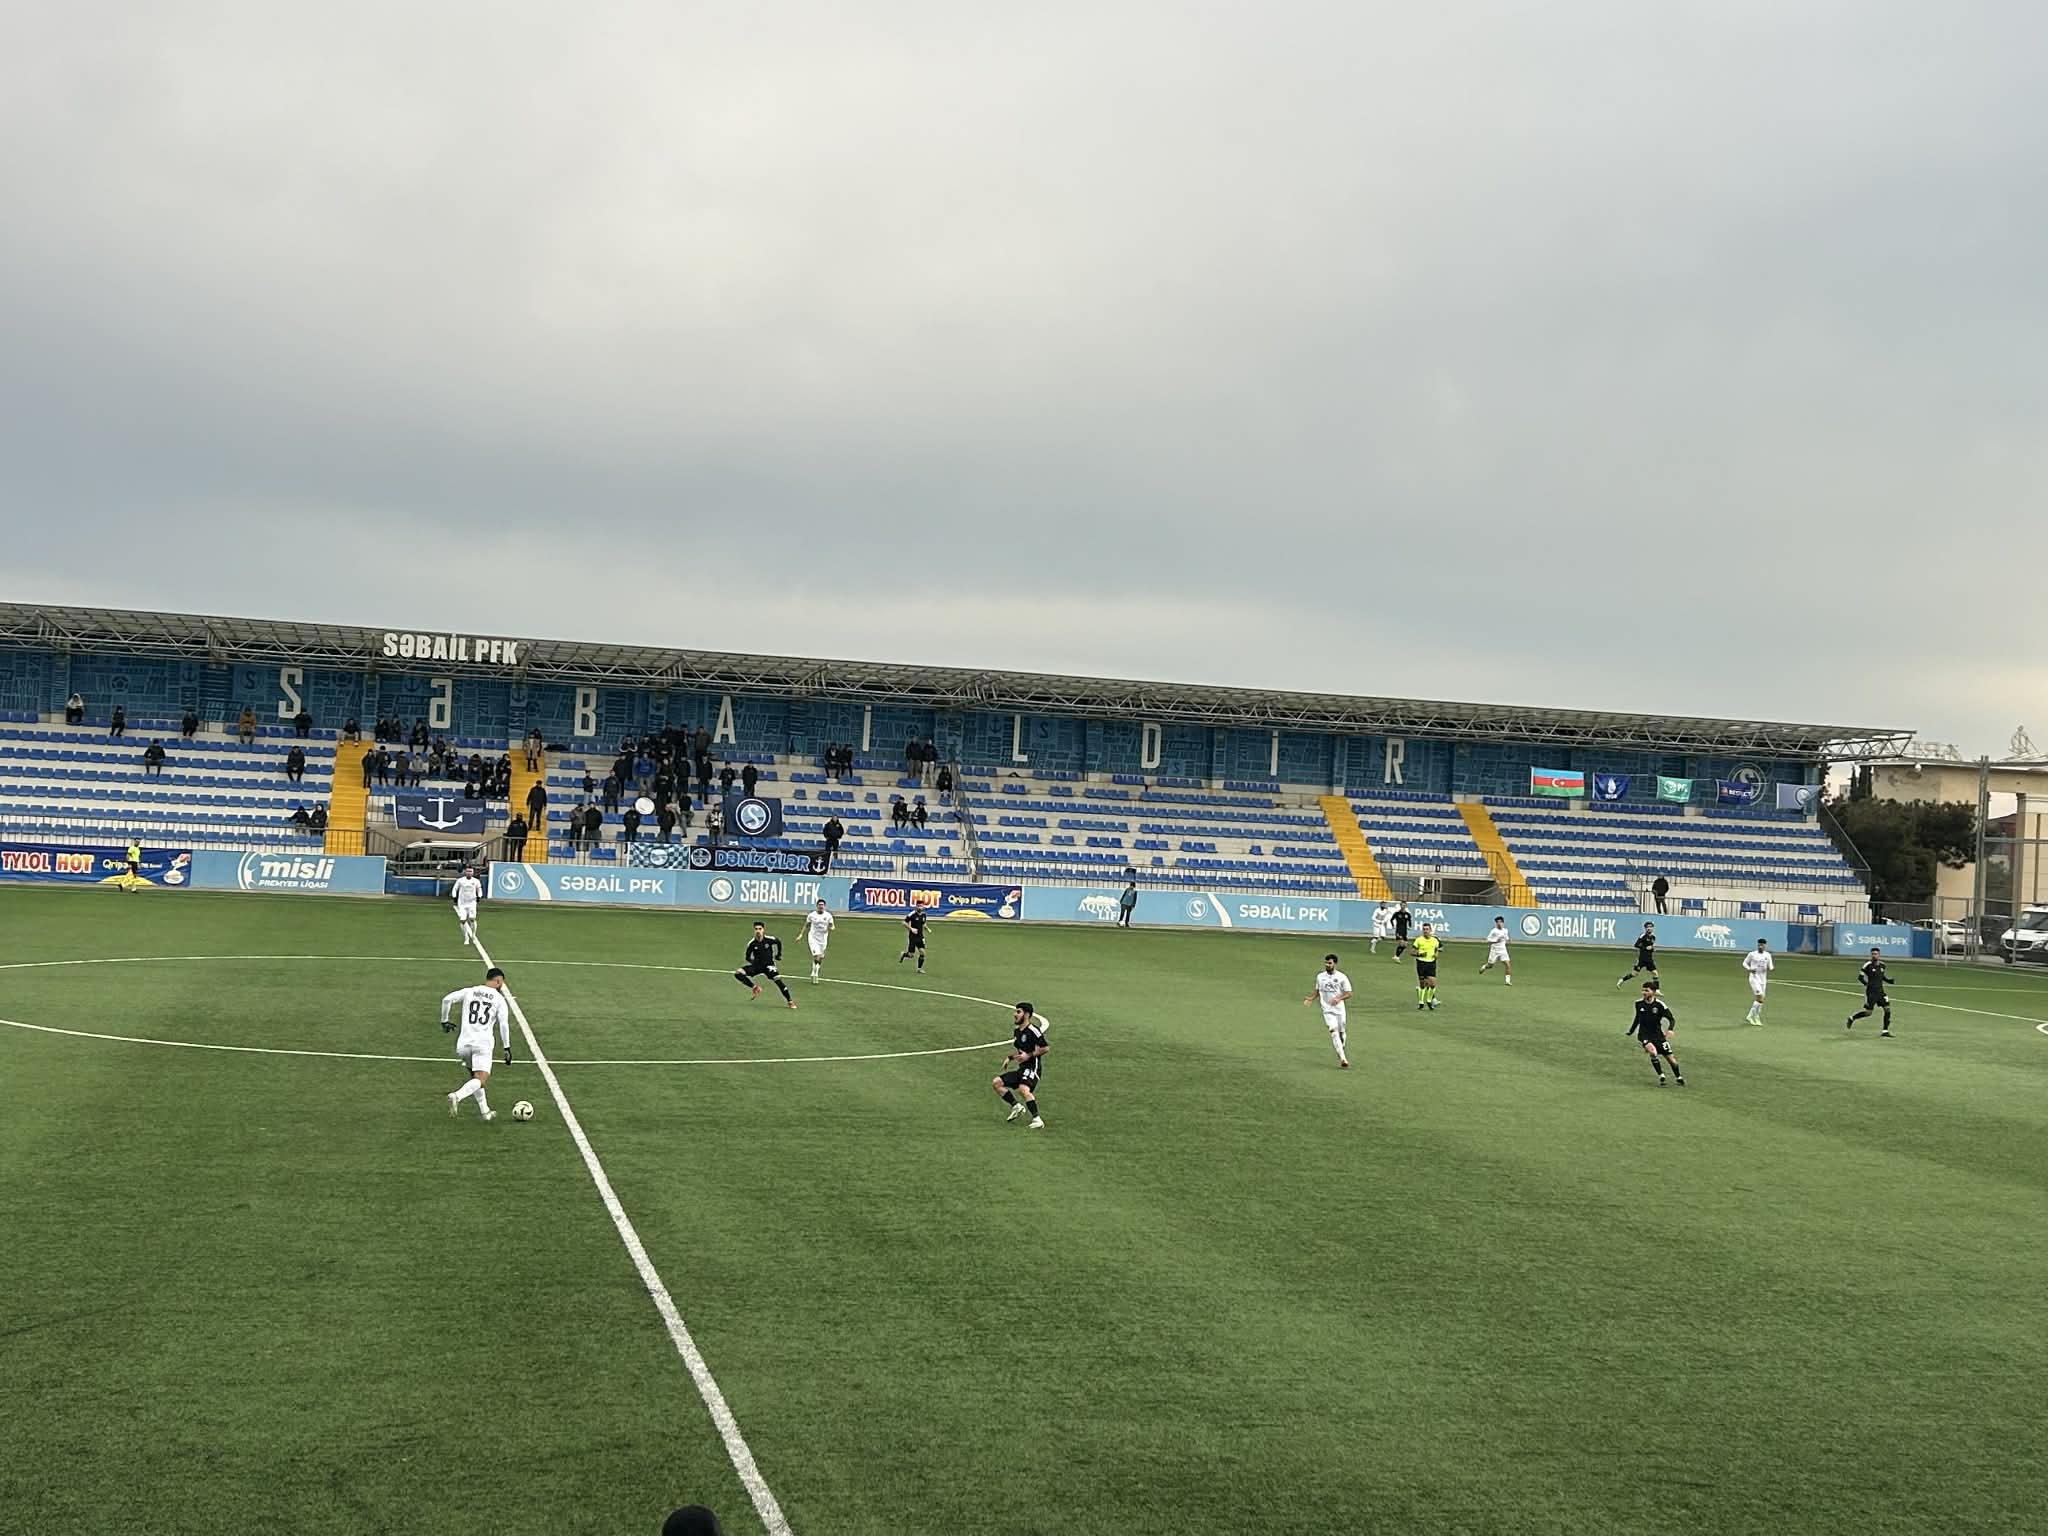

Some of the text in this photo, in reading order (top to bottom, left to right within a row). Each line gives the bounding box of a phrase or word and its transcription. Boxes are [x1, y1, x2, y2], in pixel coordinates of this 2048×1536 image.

[383, 632, 518, 664] SƏBAİL PFK
[2, 851, 95, 873] TYLOL HOT
[260, 858, 335, 880] misli
[715, 847, 811, 872] DƏNİZÇİLƏR
[560, 873, 665, 895] SƏBAİL PFK
[740, 877, 821, 905] SƏBAİL PFK
[865, 888, 906, 907] TYLOL
[910, 890, 943, 909] HOT
[1239, 903, 1329, 922] SƏBAİL PFK
[1414, 908, 1444, 921] PAŞA
[1414, 920, 1451, 933] Hyat
[1547, 914, 1617, 939] SƏBAİL PFK
[468, 1000, 492, 1025] 83
